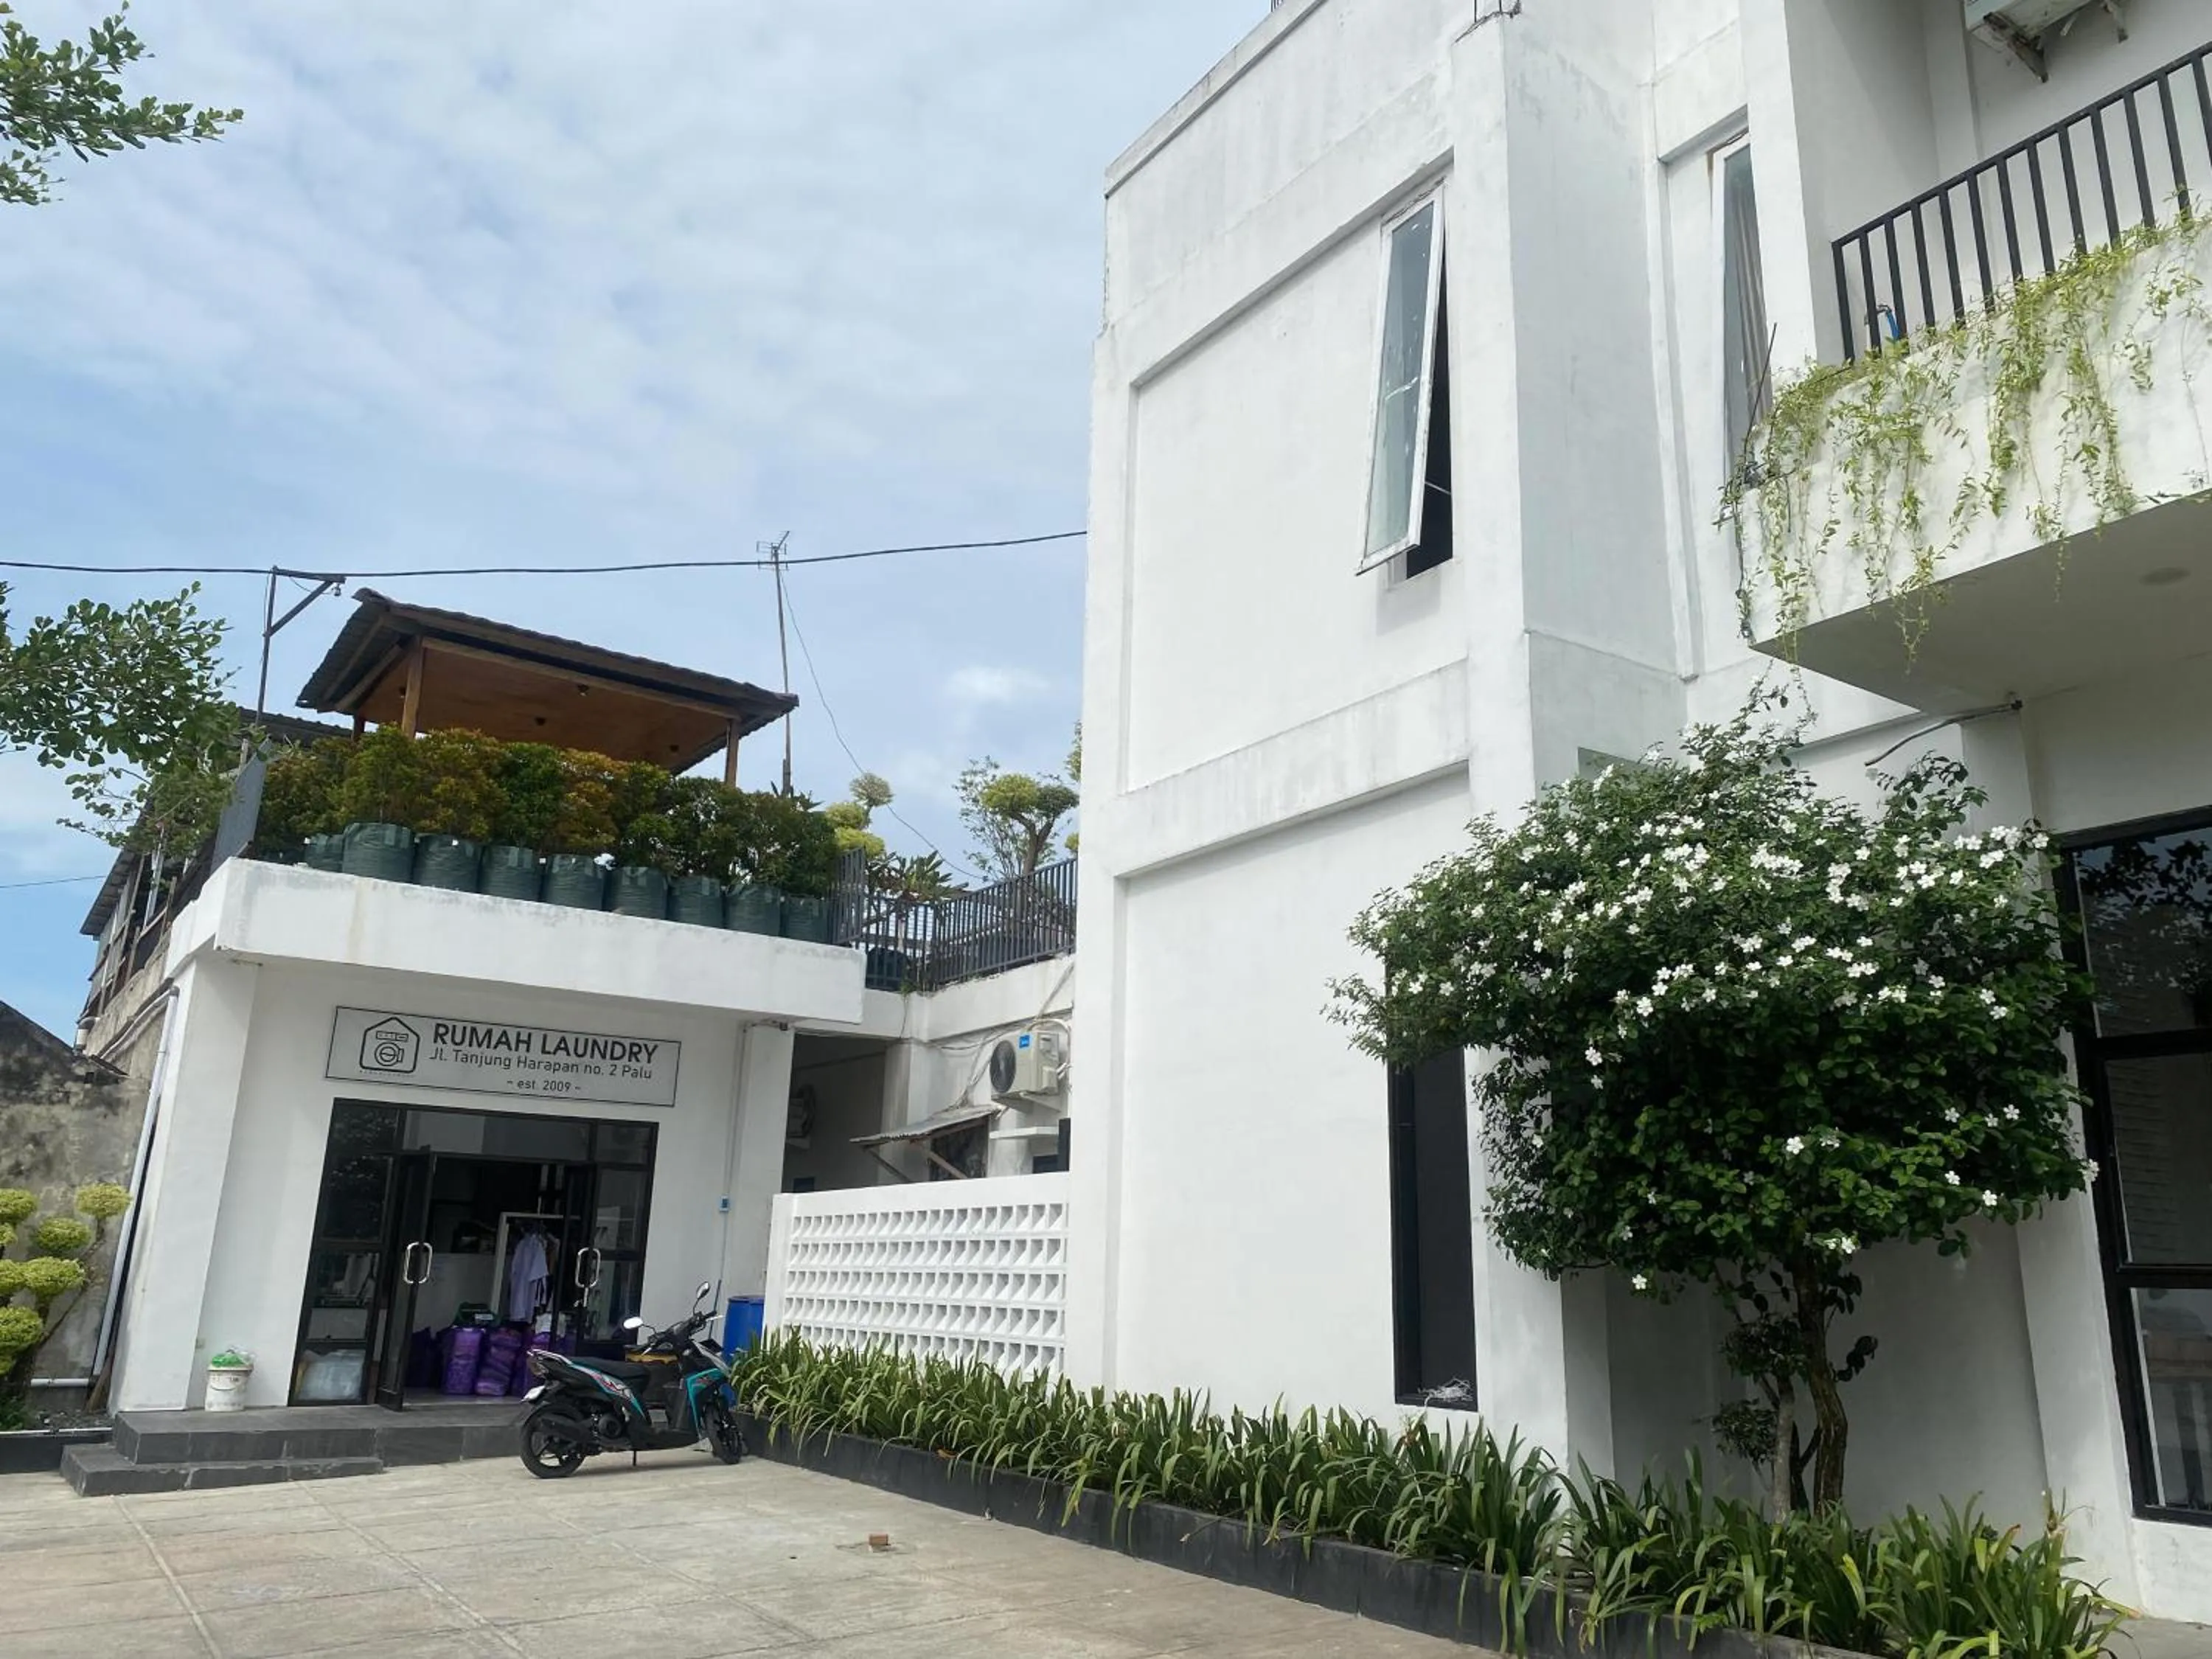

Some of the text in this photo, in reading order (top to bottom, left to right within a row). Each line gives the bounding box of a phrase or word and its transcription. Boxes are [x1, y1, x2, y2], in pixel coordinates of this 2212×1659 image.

[433, 1023, 658, 1064] RUMAH LAUNDRY
[428, 1047, 652, 1079] Jl. Tanjung Harapan no. 2 Palu
[543, 1080, 571, 1092] 2009
